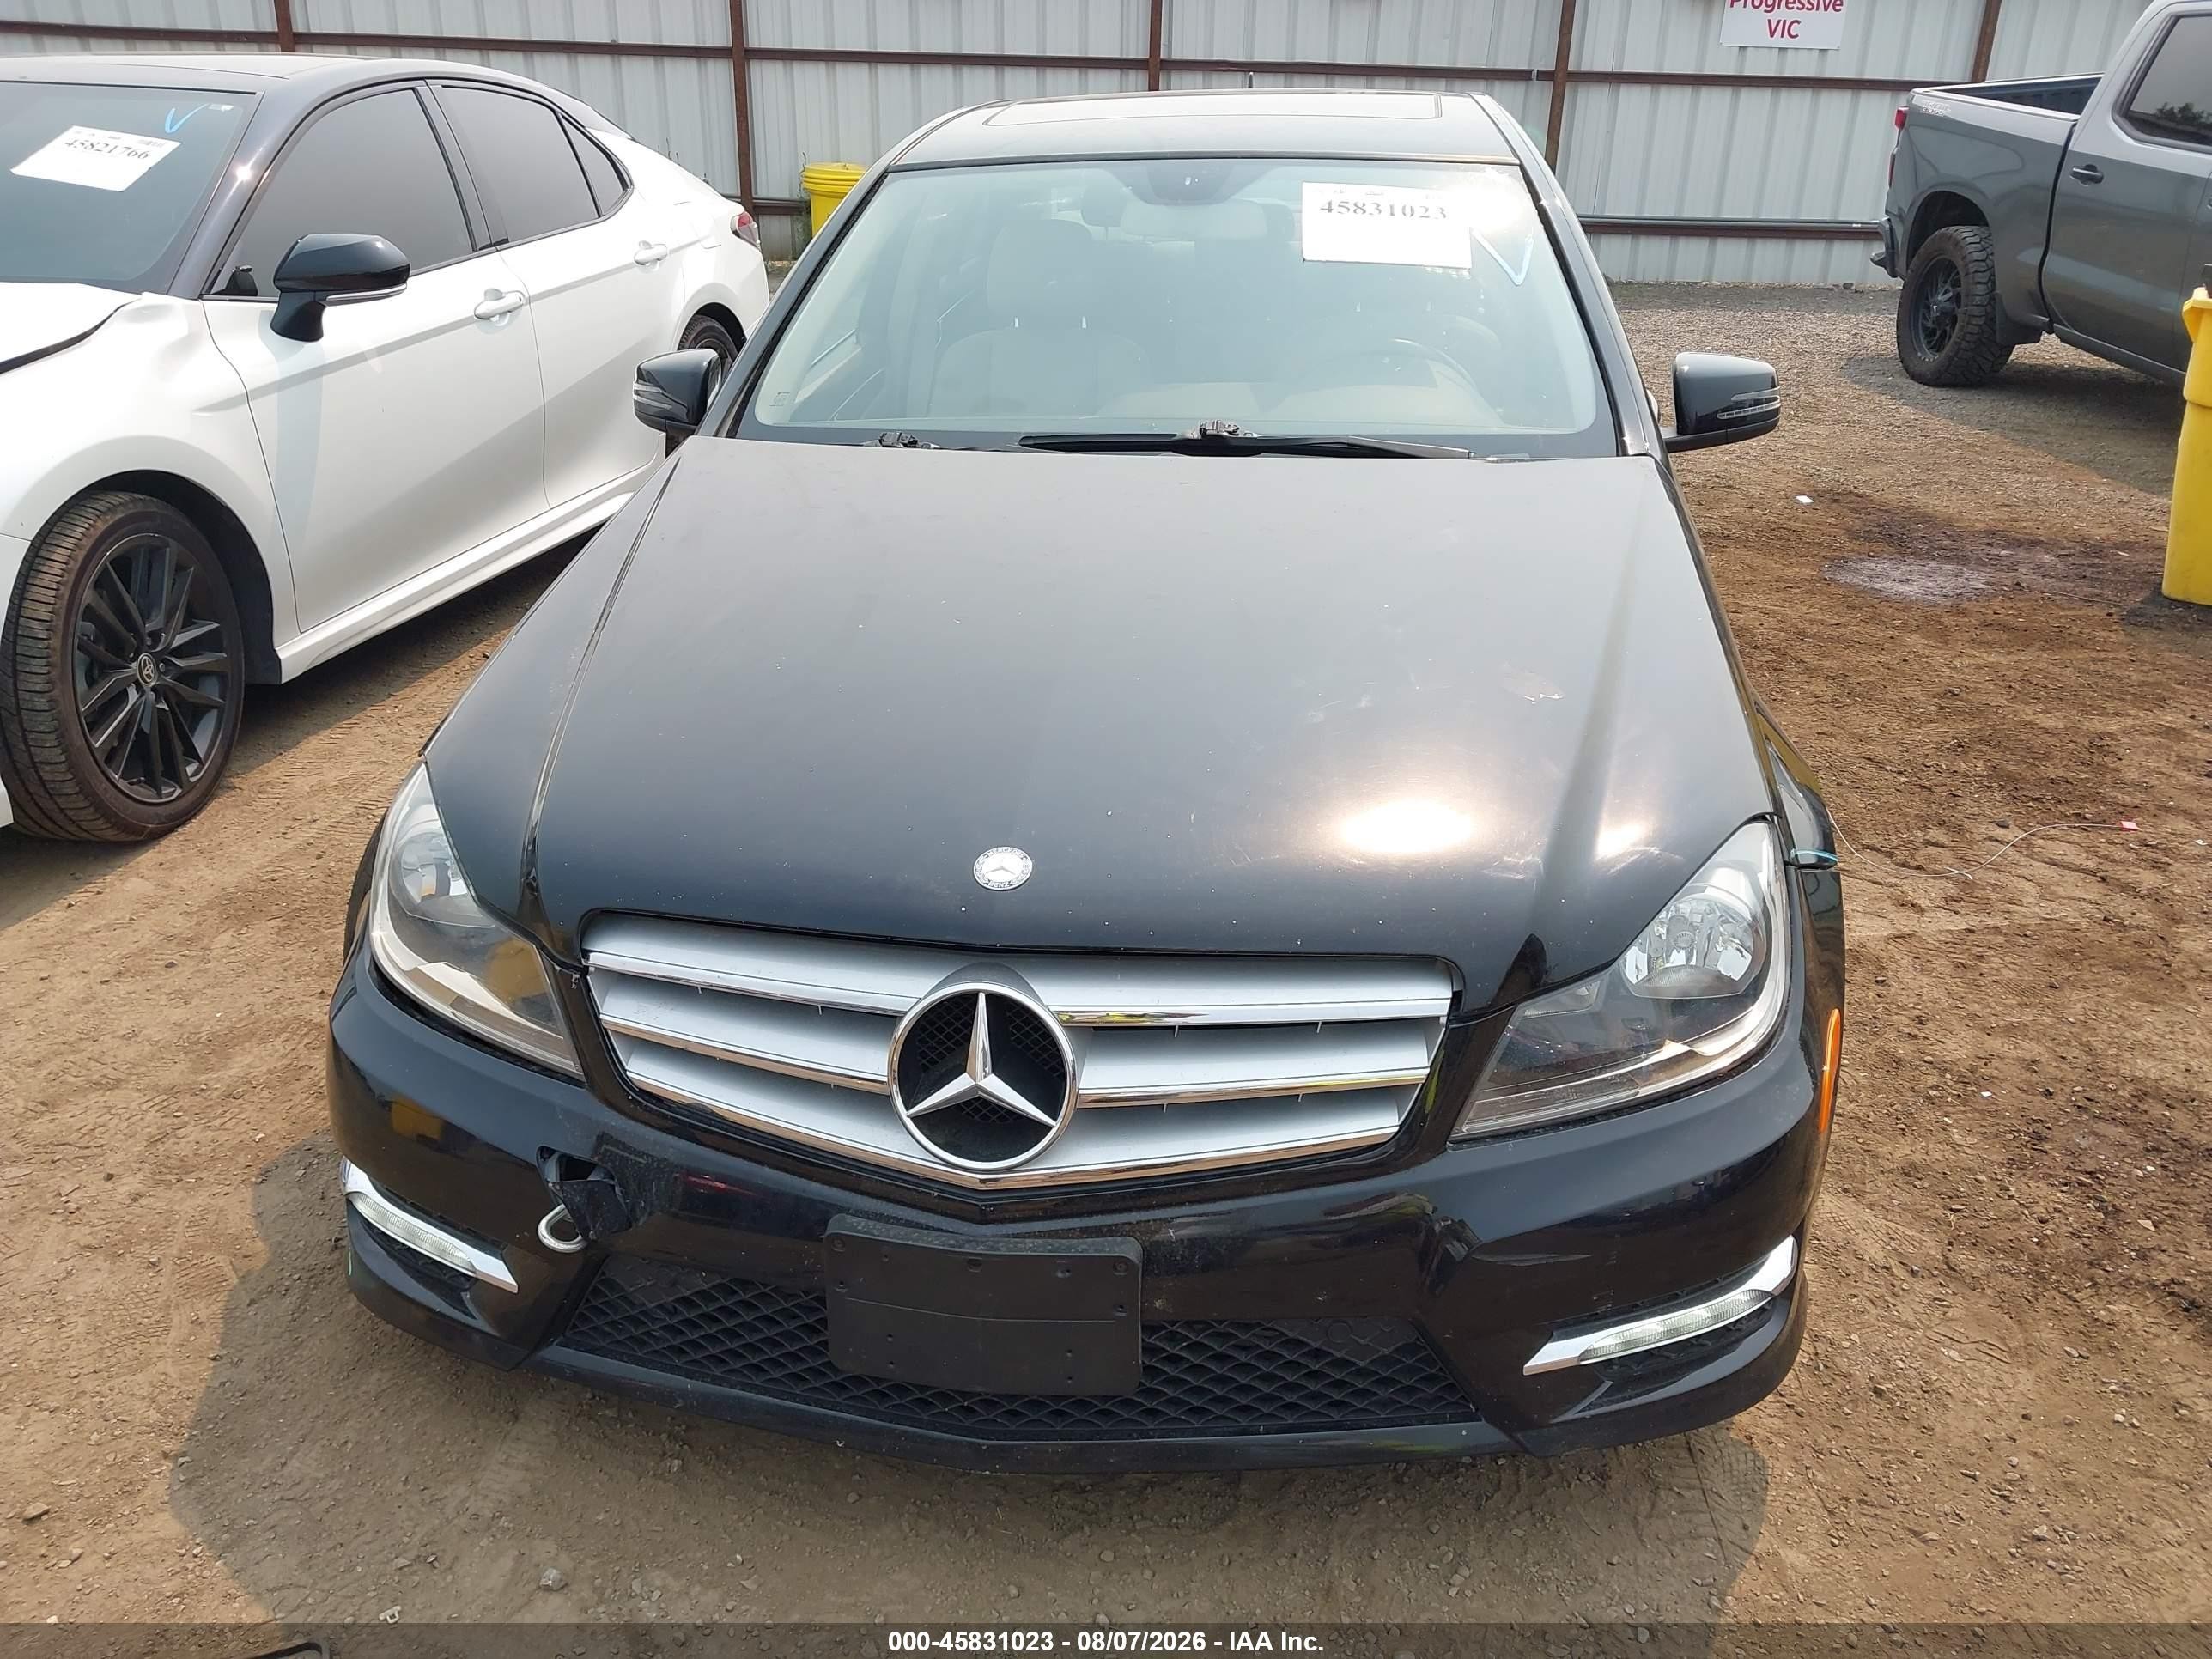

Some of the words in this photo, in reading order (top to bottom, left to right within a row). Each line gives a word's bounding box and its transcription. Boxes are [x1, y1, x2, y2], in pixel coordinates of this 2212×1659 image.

[1767, 18, 1802, 39] VIC
[64, 139, 149, 159] 45821766
[1320, 199, 1447, 220] 45831023
